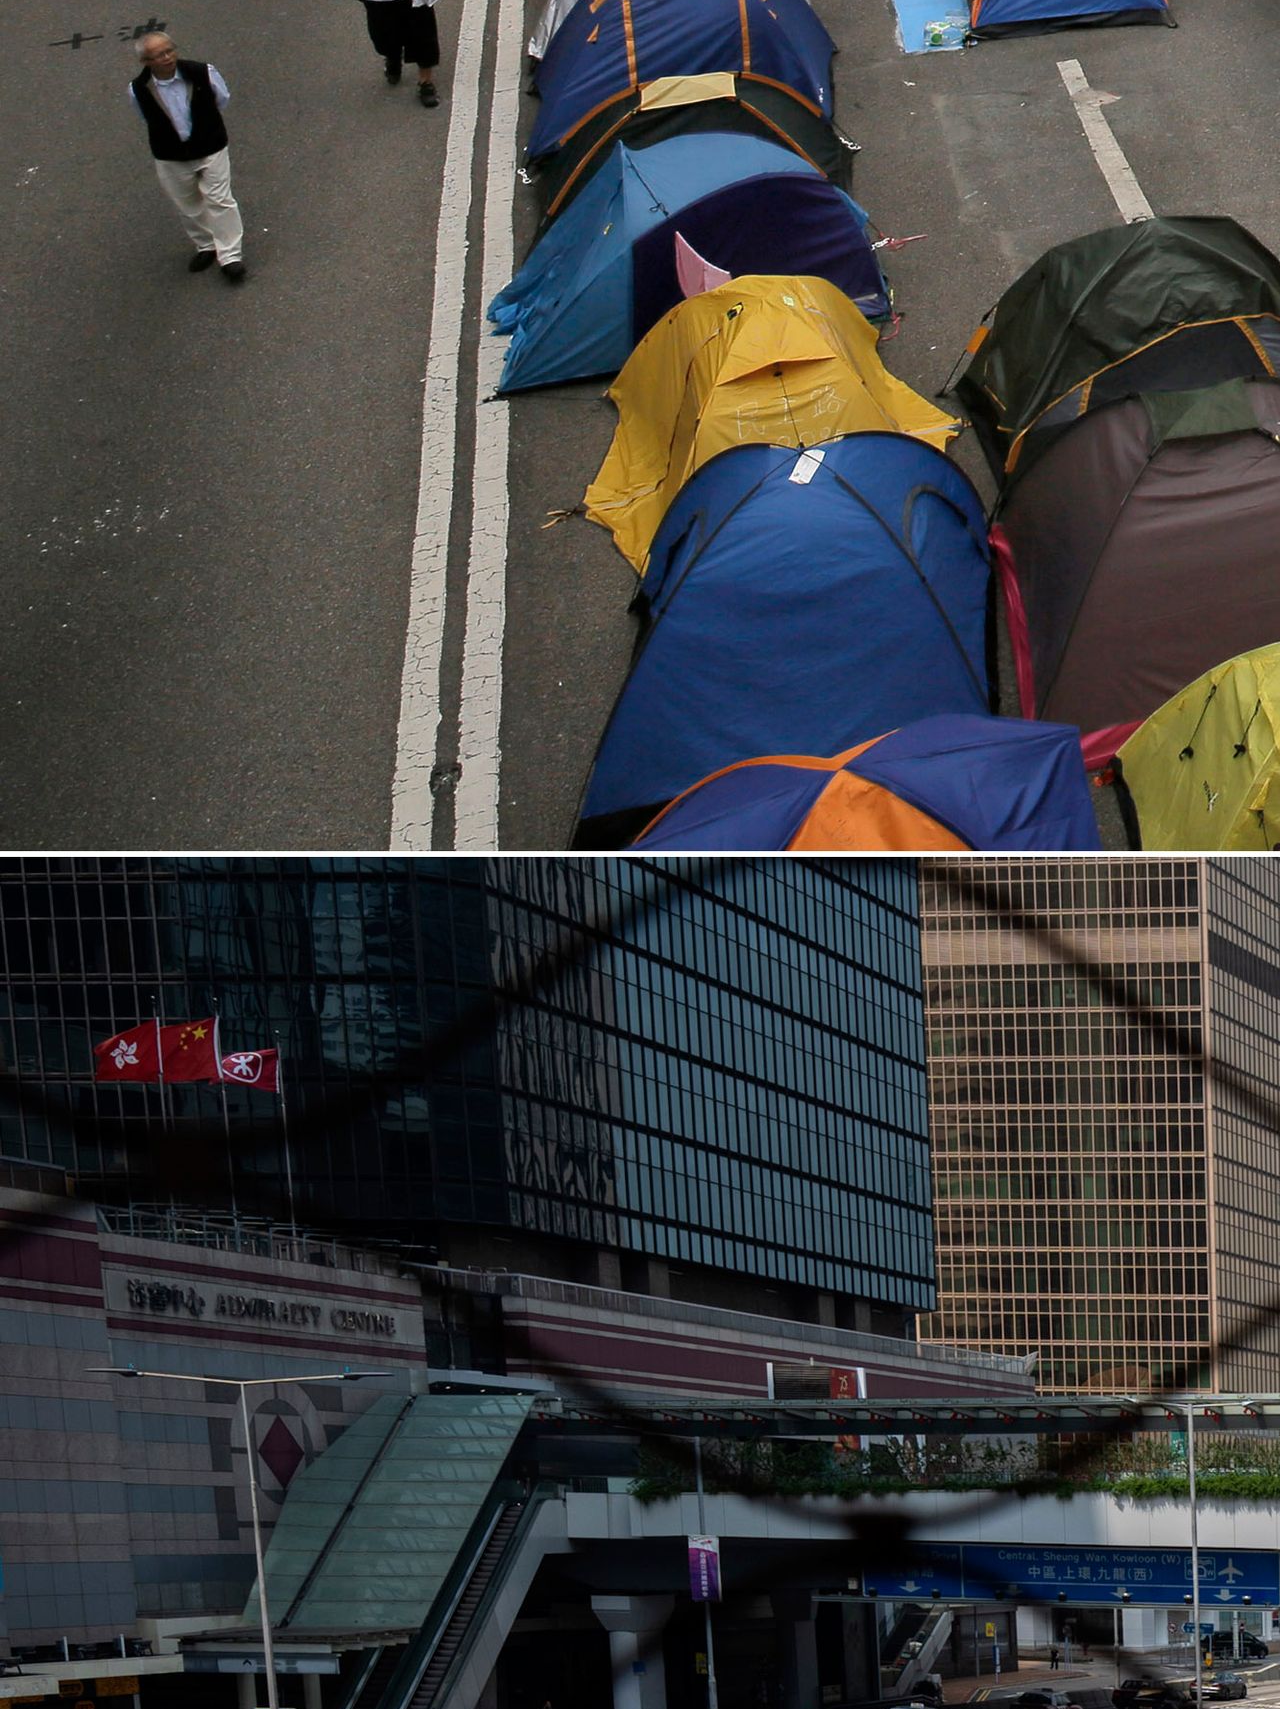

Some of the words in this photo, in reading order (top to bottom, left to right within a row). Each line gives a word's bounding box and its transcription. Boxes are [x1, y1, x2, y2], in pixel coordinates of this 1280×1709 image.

[216, 1294, 322, 1326] ADMIRALTY
[330, 1307, 397, 1337] CENTRE
[1045, 1551, 1080, 1568] Sheung
[1112, 1555, 1156, 1568] Kowloon
[1160, 1555, 1182, 1569] (W)
